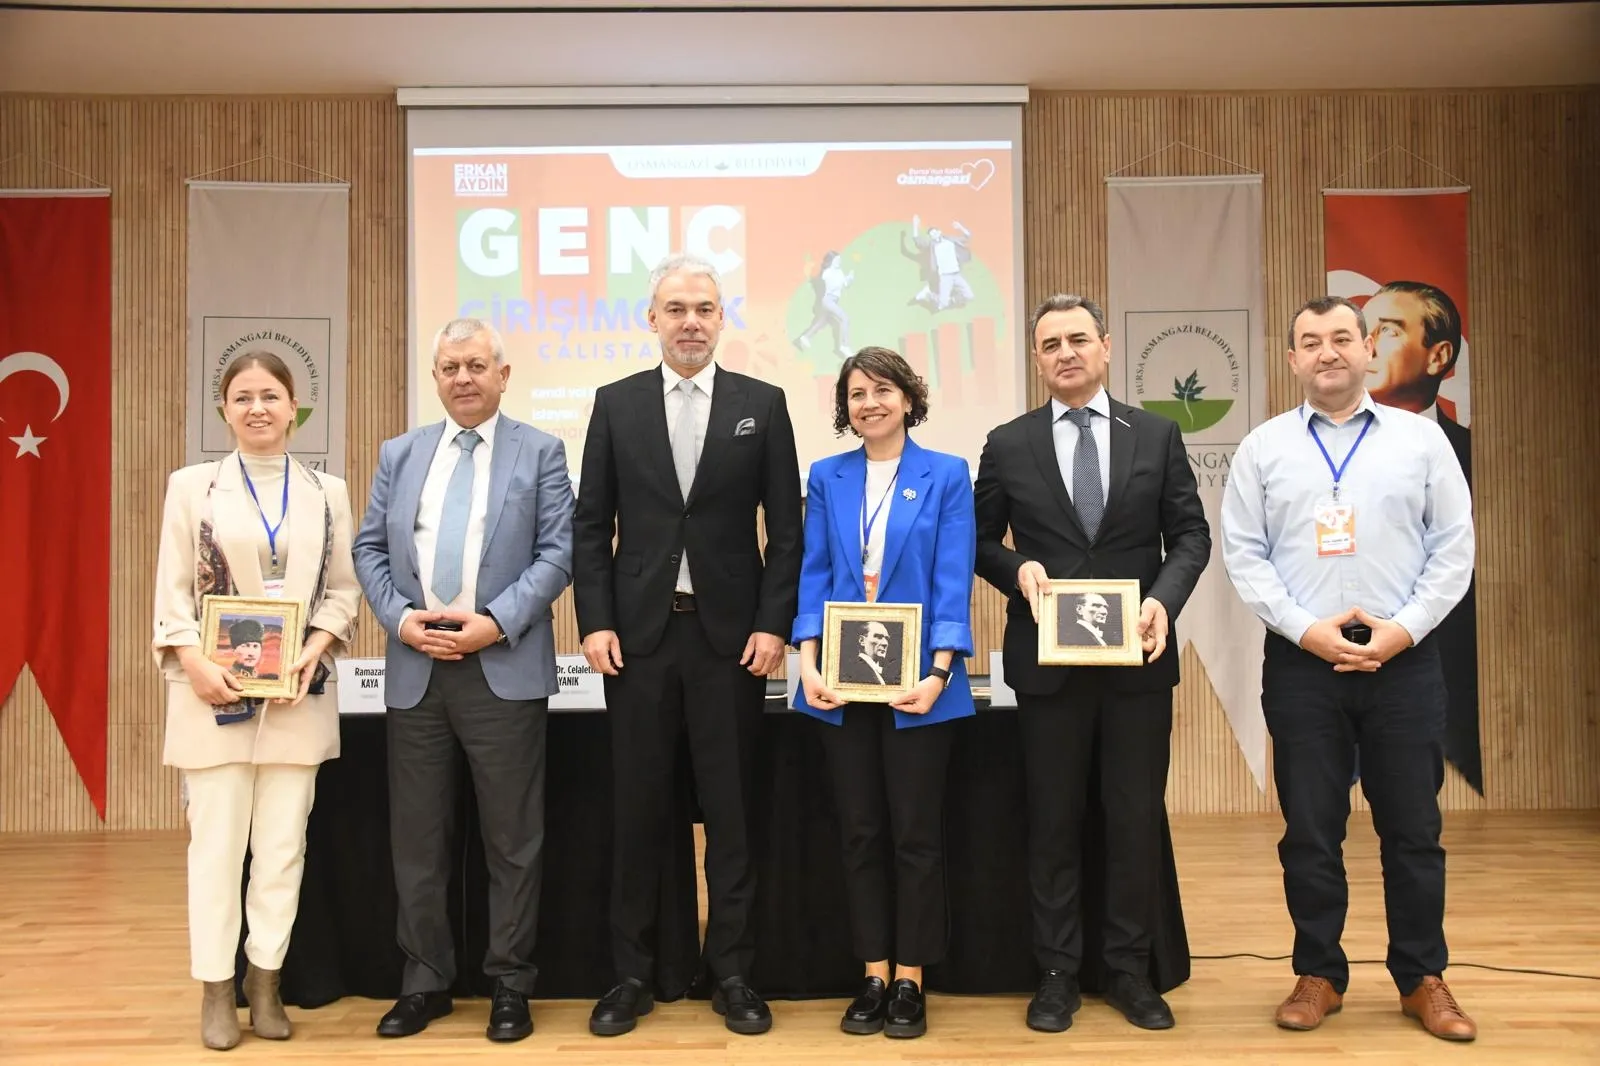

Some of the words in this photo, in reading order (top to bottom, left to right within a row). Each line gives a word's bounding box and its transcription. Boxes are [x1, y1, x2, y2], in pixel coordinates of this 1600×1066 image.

[454, 163, 508, 177] ERKAN
[457, 178, 505, 190] AYDIN
[896, 172, 972, 187] Osmangazi
[1135, 362, 1146, 395] BURSA
[1141, 322, 1194, 360] OSMANGAZİ
[1195, 325, 1240, 371] BELEDİYESİ
[1231, 373, 1240, 393] 1987
[212, 368, 223, 401] BURSA
[220, 329, 272, 366] OSMANGAZİ
[274, 332, 320, 379] BELEDİYESİ
[310, 381, 320, 403] 1987
[361, 679, 379, 688] KAYA
[558, 676, 579, 686] YANIK
